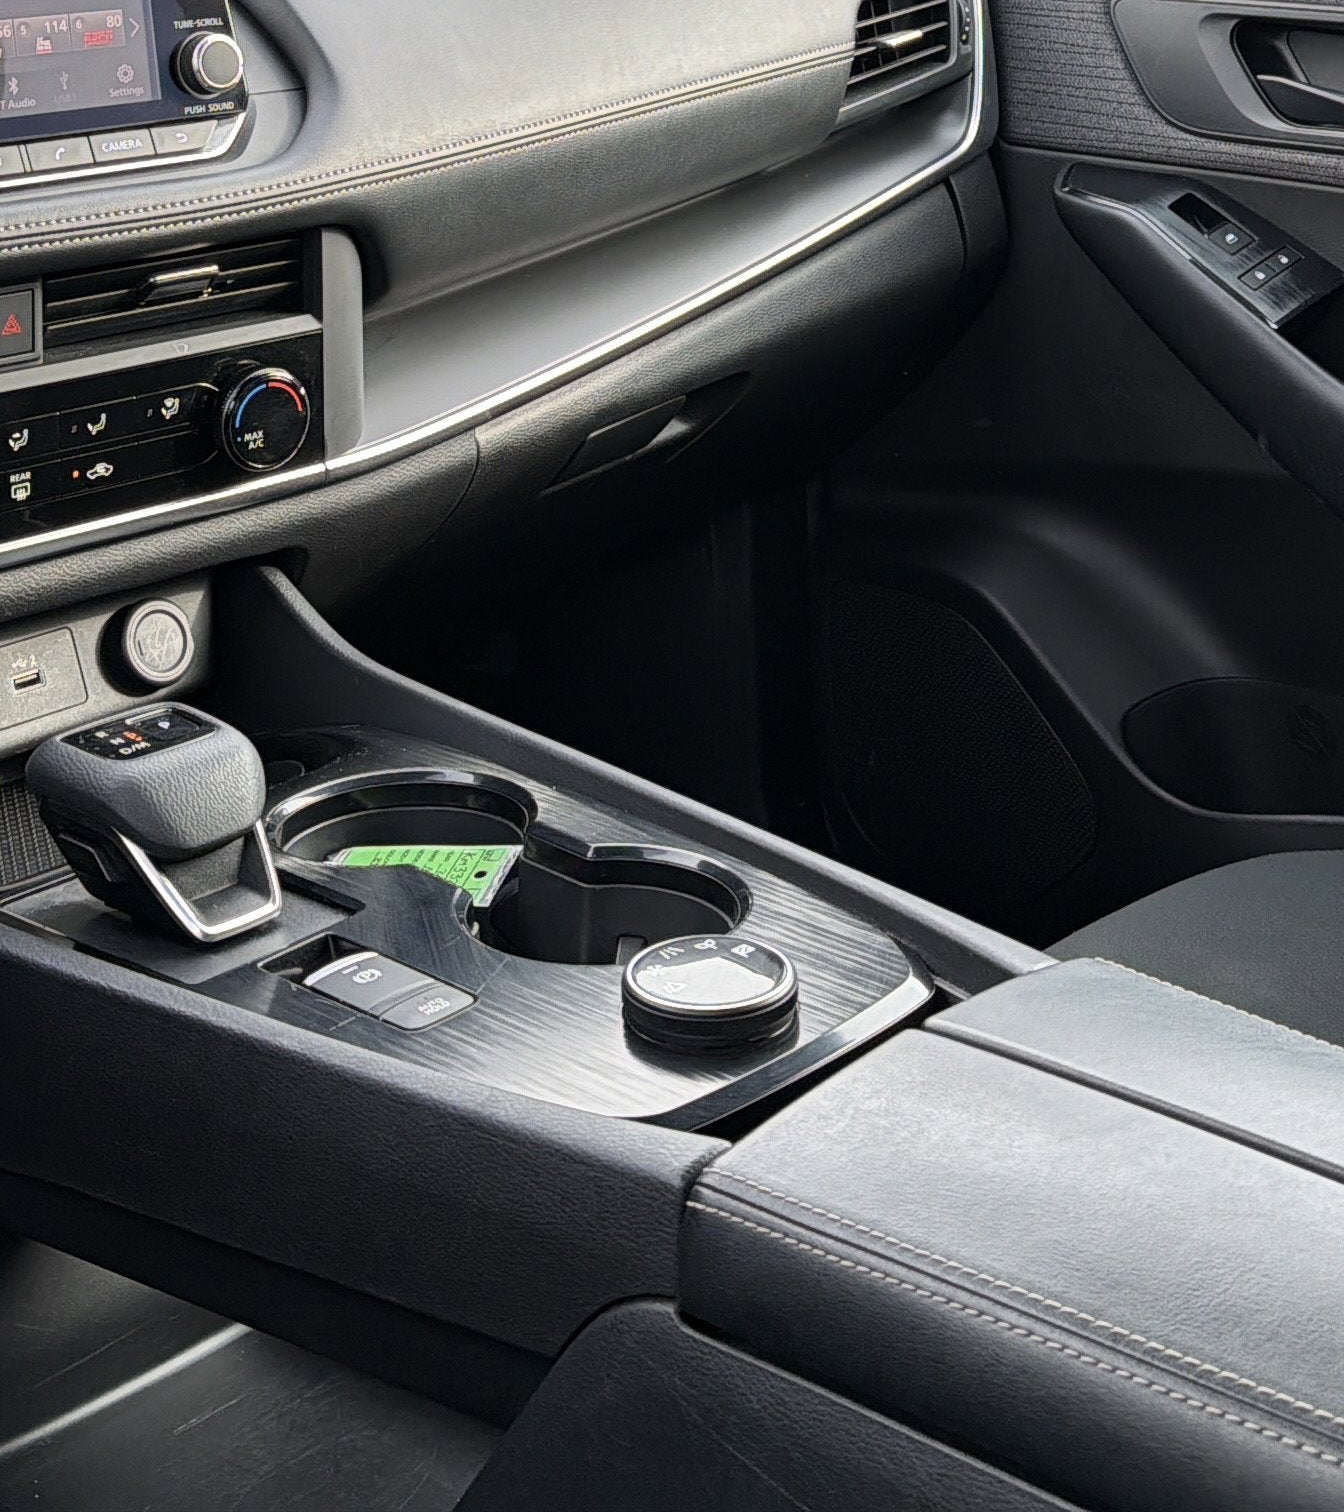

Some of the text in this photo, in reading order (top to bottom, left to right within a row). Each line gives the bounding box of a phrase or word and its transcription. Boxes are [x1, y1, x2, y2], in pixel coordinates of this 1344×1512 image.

[20, 20, 68, 36] 5 114
[75, 15, 122, 30] 6 80
[109, 86, 145, 99] Settings
[7, 98, 36, 110] Audio
[184, 101, 235, 115] PUSH SOUND
[102, 138, 143, 154] CAMERA
[244, 430, 264, 443] MAX
[248, 439, 265, 450] A/C
[10, 472, 31, 484] REAR
[417, 997, 445, 1012] AUTO
[423, 1000, 451, 1016] HOLD
